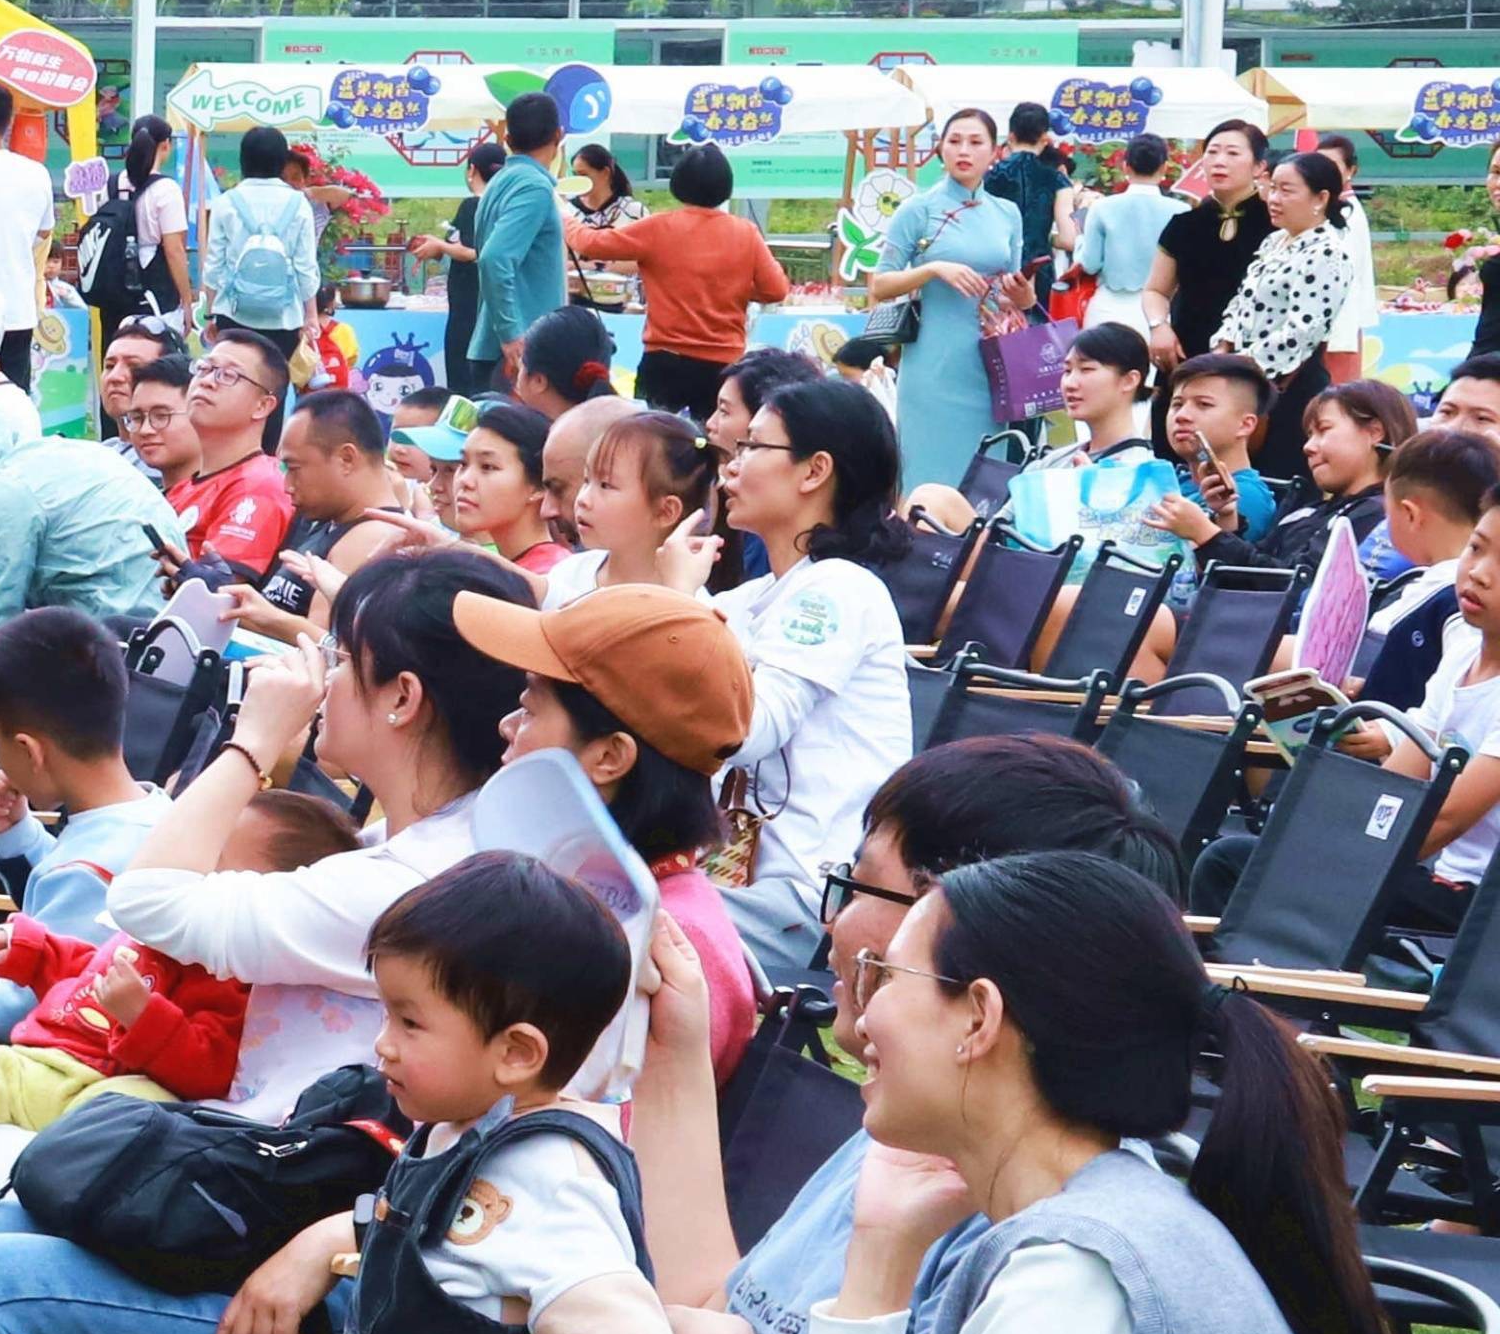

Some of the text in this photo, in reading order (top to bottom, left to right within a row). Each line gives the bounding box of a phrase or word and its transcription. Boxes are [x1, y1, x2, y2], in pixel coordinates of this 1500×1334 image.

[338, 76, 409, 99] 蓝果飘香
[1060, 84, 1132, 108] 蓝果飘香
[192, 90, 306, 116] WELCOME
[351, 98, 420, 119] 春意盎然
[692, 89, 763, 112] 蓝果飘香
[1422, 88, 1494, 111] 蓝果飘香
[705, 111, 773, 131] 春意盎然
[1069, 106, 1139, 129] 春意盎然
